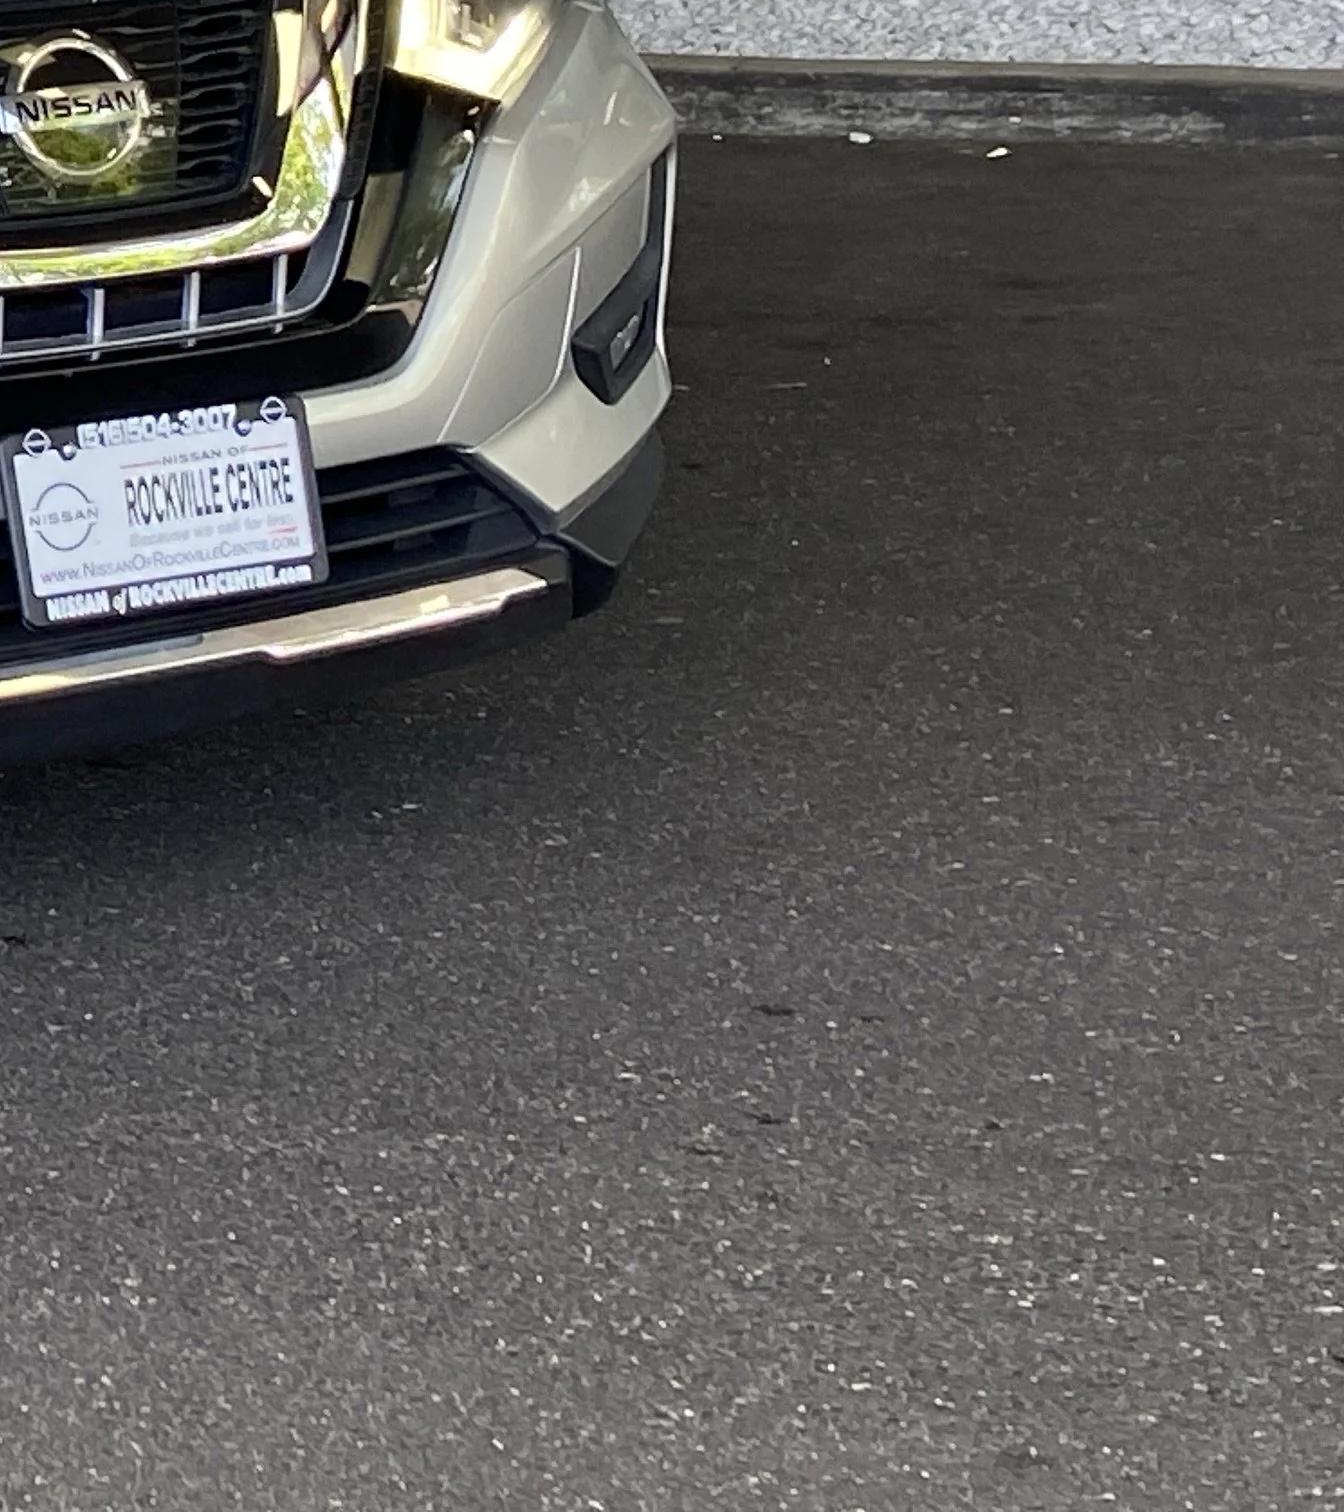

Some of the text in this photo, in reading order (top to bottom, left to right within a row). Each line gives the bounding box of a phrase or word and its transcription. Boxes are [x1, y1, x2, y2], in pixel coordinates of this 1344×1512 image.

[15, 88, 138, 123] NISSAN
[162, 448, 222, 466] NISSAN
[123, 457, 294, 528] ROCKVILLE CENTRE
[28, 507, 99, 528] NISSAN
